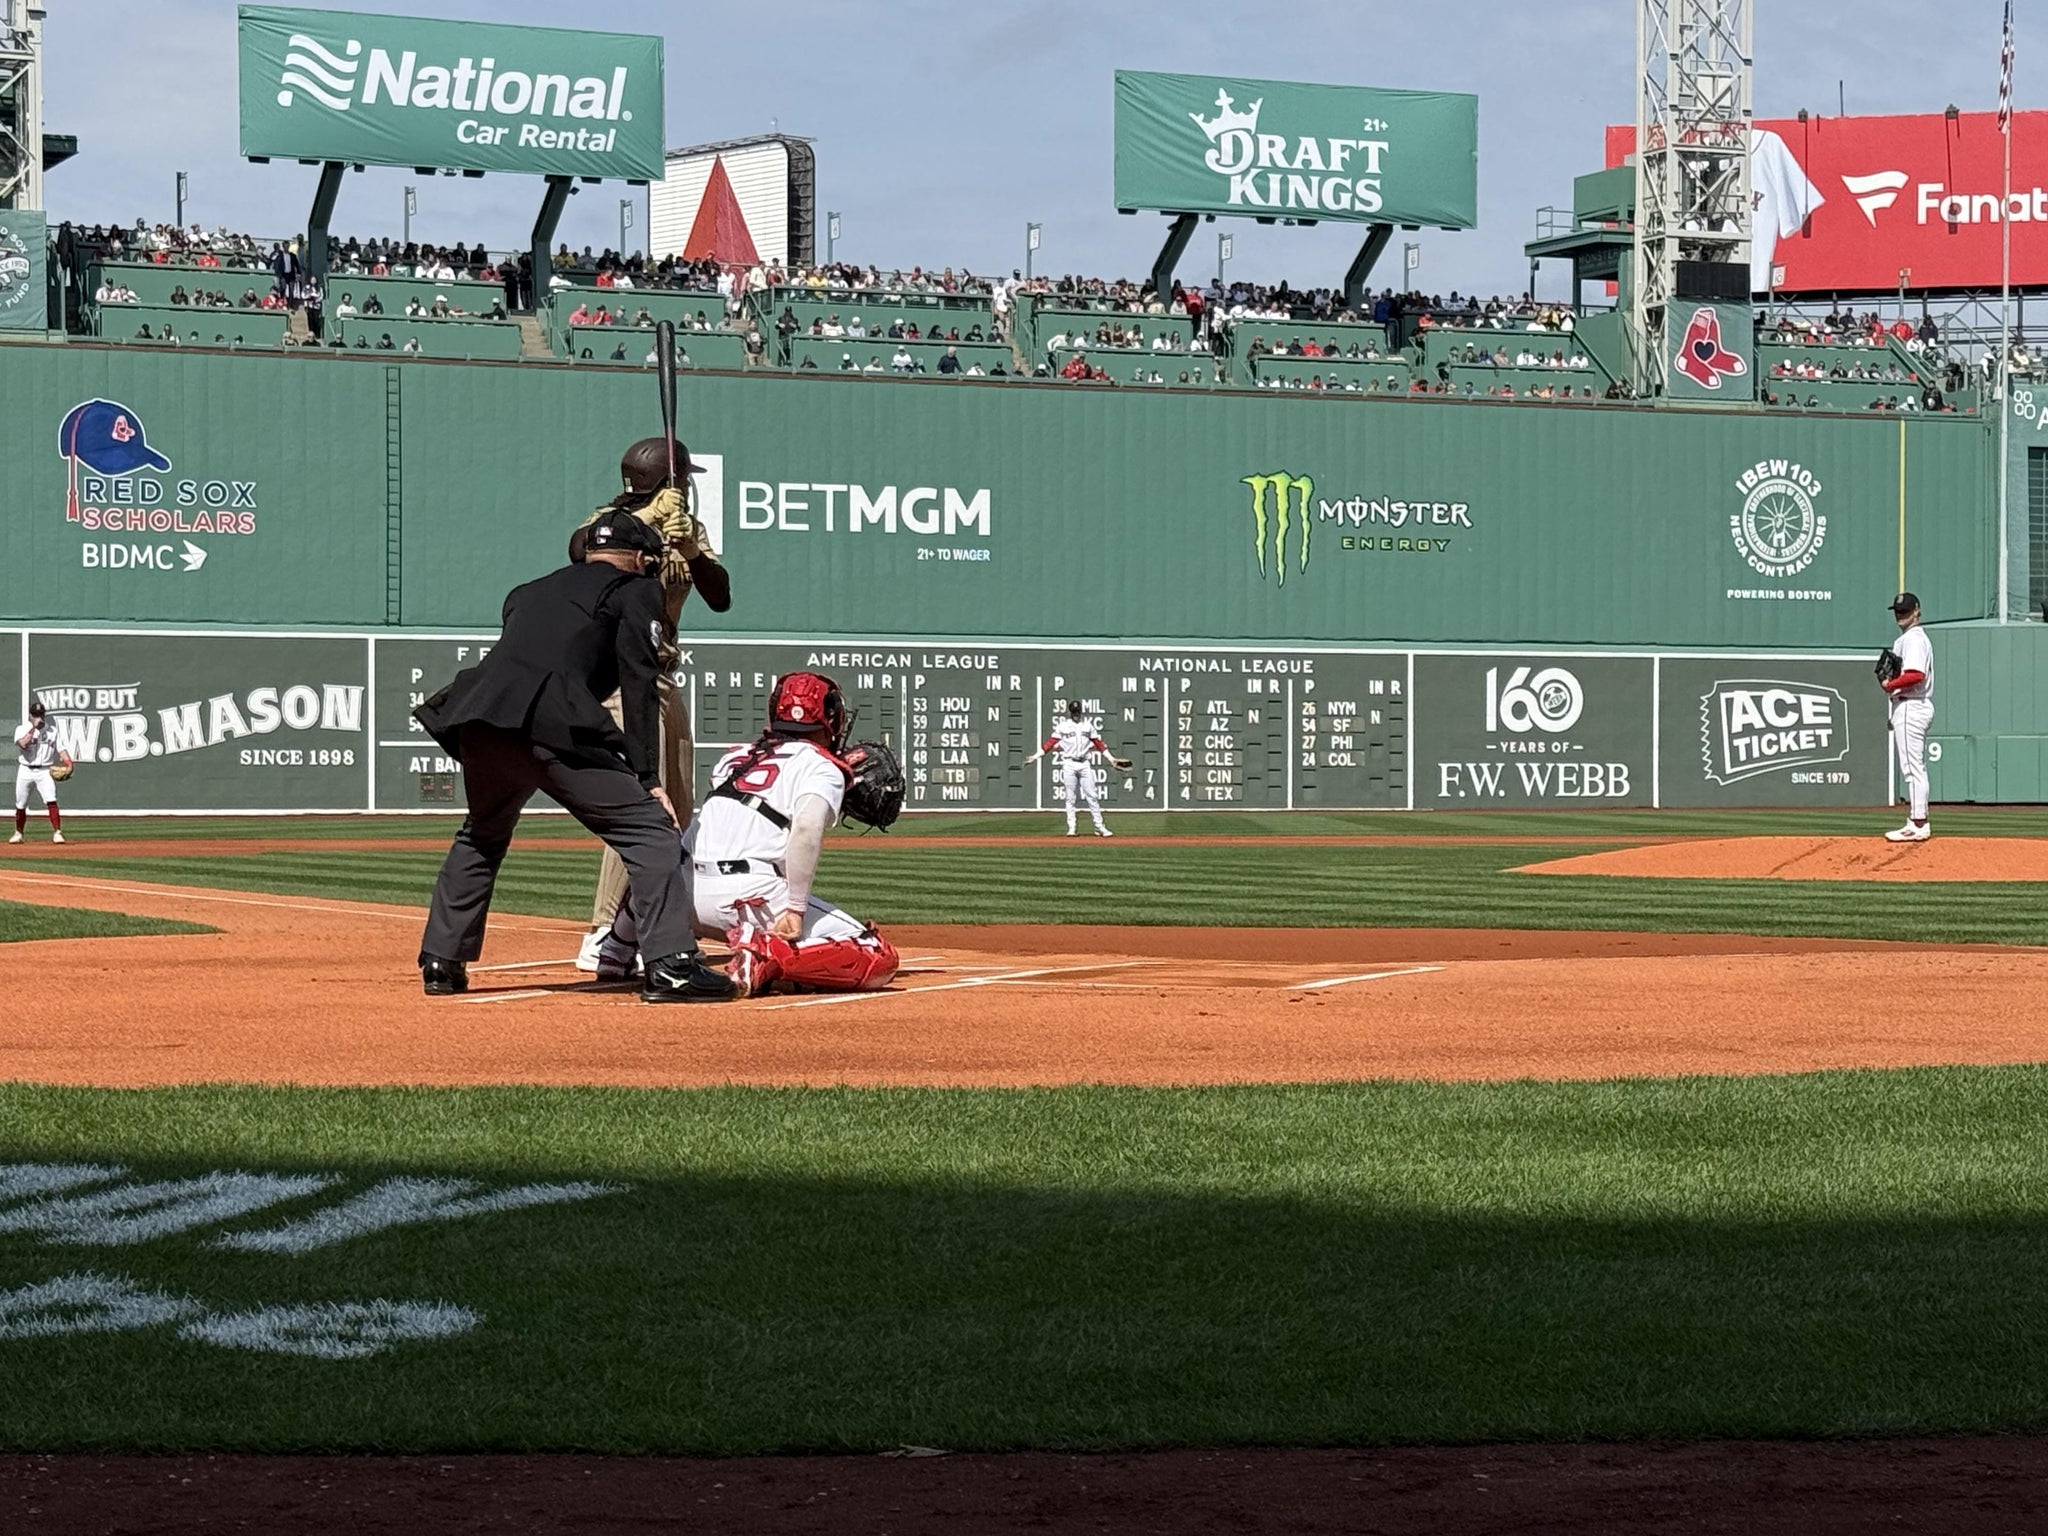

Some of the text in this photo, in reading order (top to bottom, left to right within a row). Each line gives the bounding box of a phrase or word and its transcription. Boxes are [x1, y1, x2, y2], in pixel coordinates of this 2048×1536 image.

[1364, 119, 1388, 131] 21+
[457, 120, 616, 151] Car Rental
[1204, 129, 1389, 175] DRAFT
[1227, 168, 1384, 212] KINGS
[10, 233, 29, 254] SOX
[5, 283, 29, 308] FUND
[1735, 459, 1822, 498] IBEW 103
[84, 477, 256, 508] RED SOX
[739, 481, 991, 536] BETMGM
[1318, 495, 1473, 529] MONSTER
[82, 508, 256, 534] SCHOLARS
[1341, 537, 1450, 552] ENERGY
[1730, 515, 1749, 558] NECA
[1747, 515, 1827, 577] CONTRACTORS
[83, 543, 173, 569] BIDMC
[917, 548, 991, 562] 21+ TO WAGER
[1727, 590, 1832, 600] POWERING BOSTON
[807, 653, 998, 669] AMERICAN LEAGUE
[1140, 658, 1313, 673] NATIONAL LEAGUE
[412, 669, 422, 683] P
[705, 672, 716, 687] R
[730, 672, 740, 687] H
[755, 673, 763, 687] E
[859, 674, 892, 688] IN R
[915, 675, 1020, 690] P IN R
[1055, 677, 1155, 692] P IN R
[1182, 678, 1279, 693] P IN R
[1305, 680, 1401, 694] P IN R
[37, 687, 138, 710] WHO BUT
[914, 698, 970, 711] 53 HOU
[1486, 667, 1584, 733] 160
[1053, 699, 1105, 713] 39 MIL
[1180, 700, 1232, 714] 67 ATL
[1302, 702, 1355, 715] 26 NYM
[1731, 688, 1832, 734] ACE
[989, 707, 999, 721] N
[1125, 709, 1134, 721] N
[1249, 710, 1259, 723] N
[1371, 711, 1380, 724] N
[53, 684, 365, 764] W.B.MASON
[914, 715, 968, 729] 59 ATH
[1179, 718, 1228, 731] 57 AZ
[1303, 718, 1351, 732] 54 SF
[914, 733, 969, 747] 22 SEA
[1178, 735, 1233, 749] 22 CHC
[1303, 736, 1352, 749] 27 PHI
[1733, 729, 1832, 761] TICKET
[988, 743, 998, 756] N
[1501, 742, 1569, 753] YEARS OF
[241, 750, 354, 765] SINCE 1898
[913, 750, 968, 764] 48 LAA
[1178, 752, 1233, 766] 54 CLE
[1302, 753, 1356, 767] 24 COL
[410, 757, 429, 773] AT
[913, 768, 965, 782] 36 TB
[1146, 770, 1153, 783] 7
[1180, 770, 1231, 783] 51 CIN
[1438, 763, 1630, 797] F.W. WEBB
[1791, 773, 1824, 783] SINCE
[1124, 778, 1133, 791] 4
[942, 786, 968, 799] MIN
[1146, 787, 1154, 799] 4
[1181, 786, 1233, 800] 4 TEX
